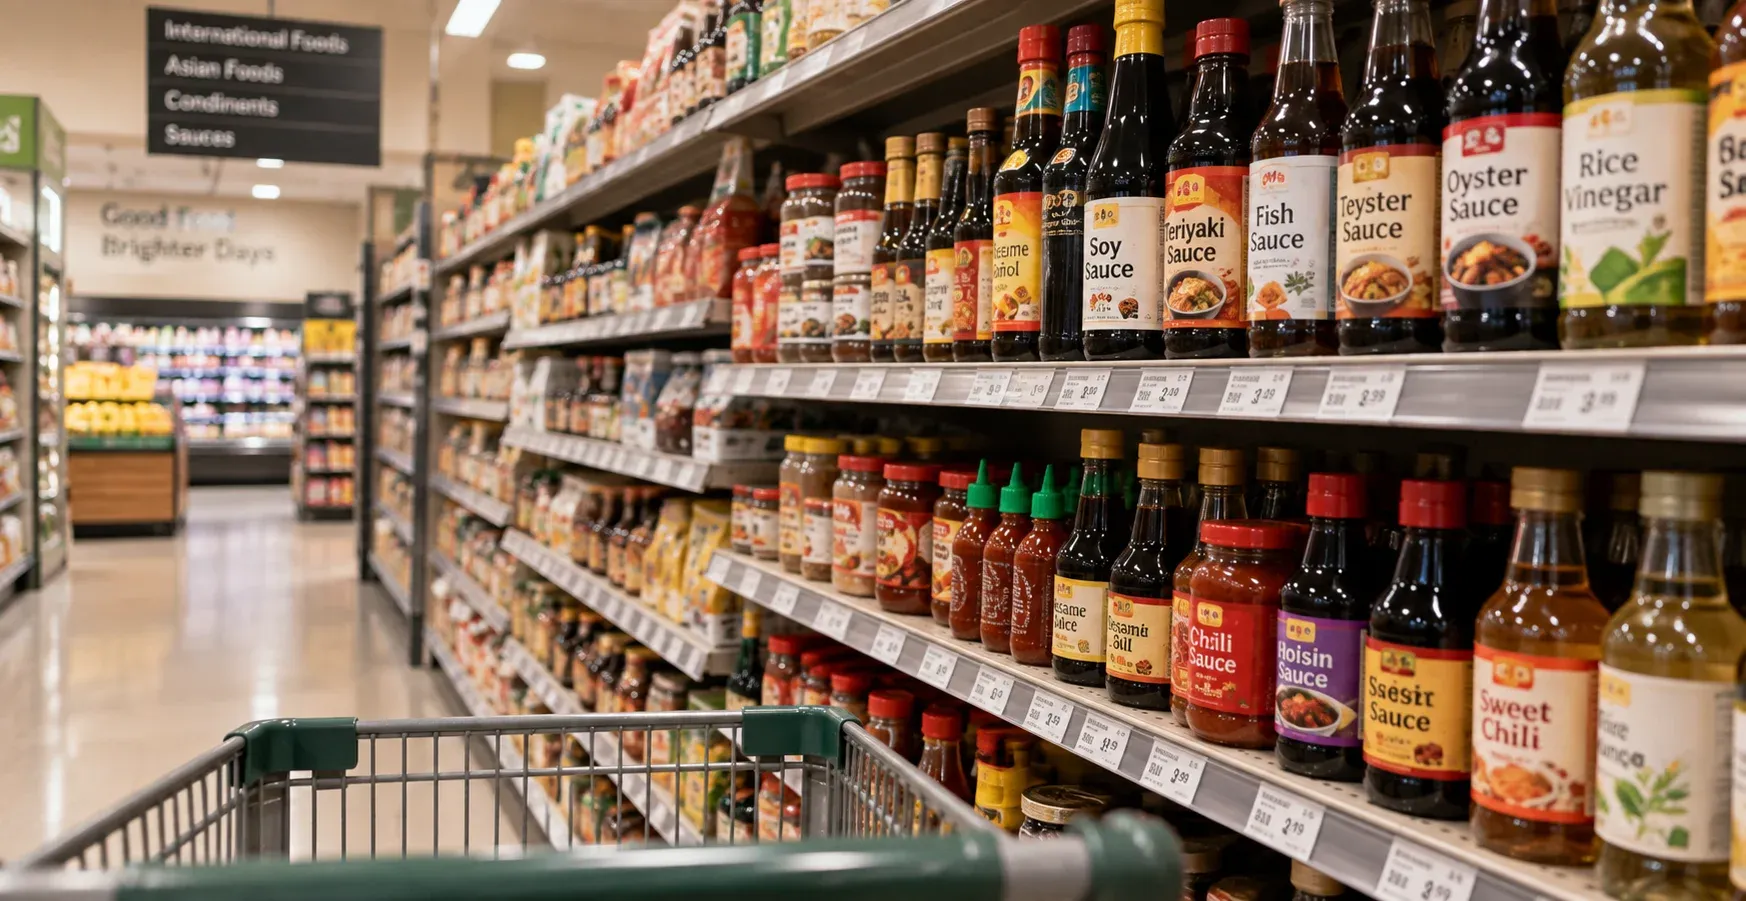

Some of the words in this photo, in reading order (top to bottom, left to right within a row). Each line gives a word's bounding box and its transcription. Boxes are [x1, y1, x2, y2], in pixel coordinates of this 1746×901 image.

[165, 19, 288, 49] International
[290, 29, 349, 54] Foods
[164, 54, 221, 79] Asian
[224, 58, 284, 84] Foods
[164, 123, 236, 148] Sauces
[1580, 149, 1639, 178] Rice
[1448, 166, 1528, 197] Oyster
[1340, 192, 1412, 220] Teyster
[1450, 197, 1518, 221] Sauce
[1564, 182, 1668, 213] Vinegar
[101, 202, 168, 228] Good
[1256, 202, 1294, 227] Fish
[1164, 217, 1225, 244] Teriyaki
[1250, 232, 1304, 252] Sauce
[1343, 221, 1403, 242] Sauce
[101, 235, 206, 265] Brighter
[215, 238, 275, 269] Days
[1089, 237, 1122, 260] Soy
[1168, 245, 1217, 264] Sauce
[1085, 262, 1134, 280] Sauce
[1188, 647, 1237, 673] Sauce
[1278, 641, 1333, 669] Hoisin
[1278, 662, 1328, 688] Sauce
[1370, 701, 1431, 732] Sauce
[1480, 688, 1552, 723] Sweet
[1482, 717, 1540, 750] Chili
